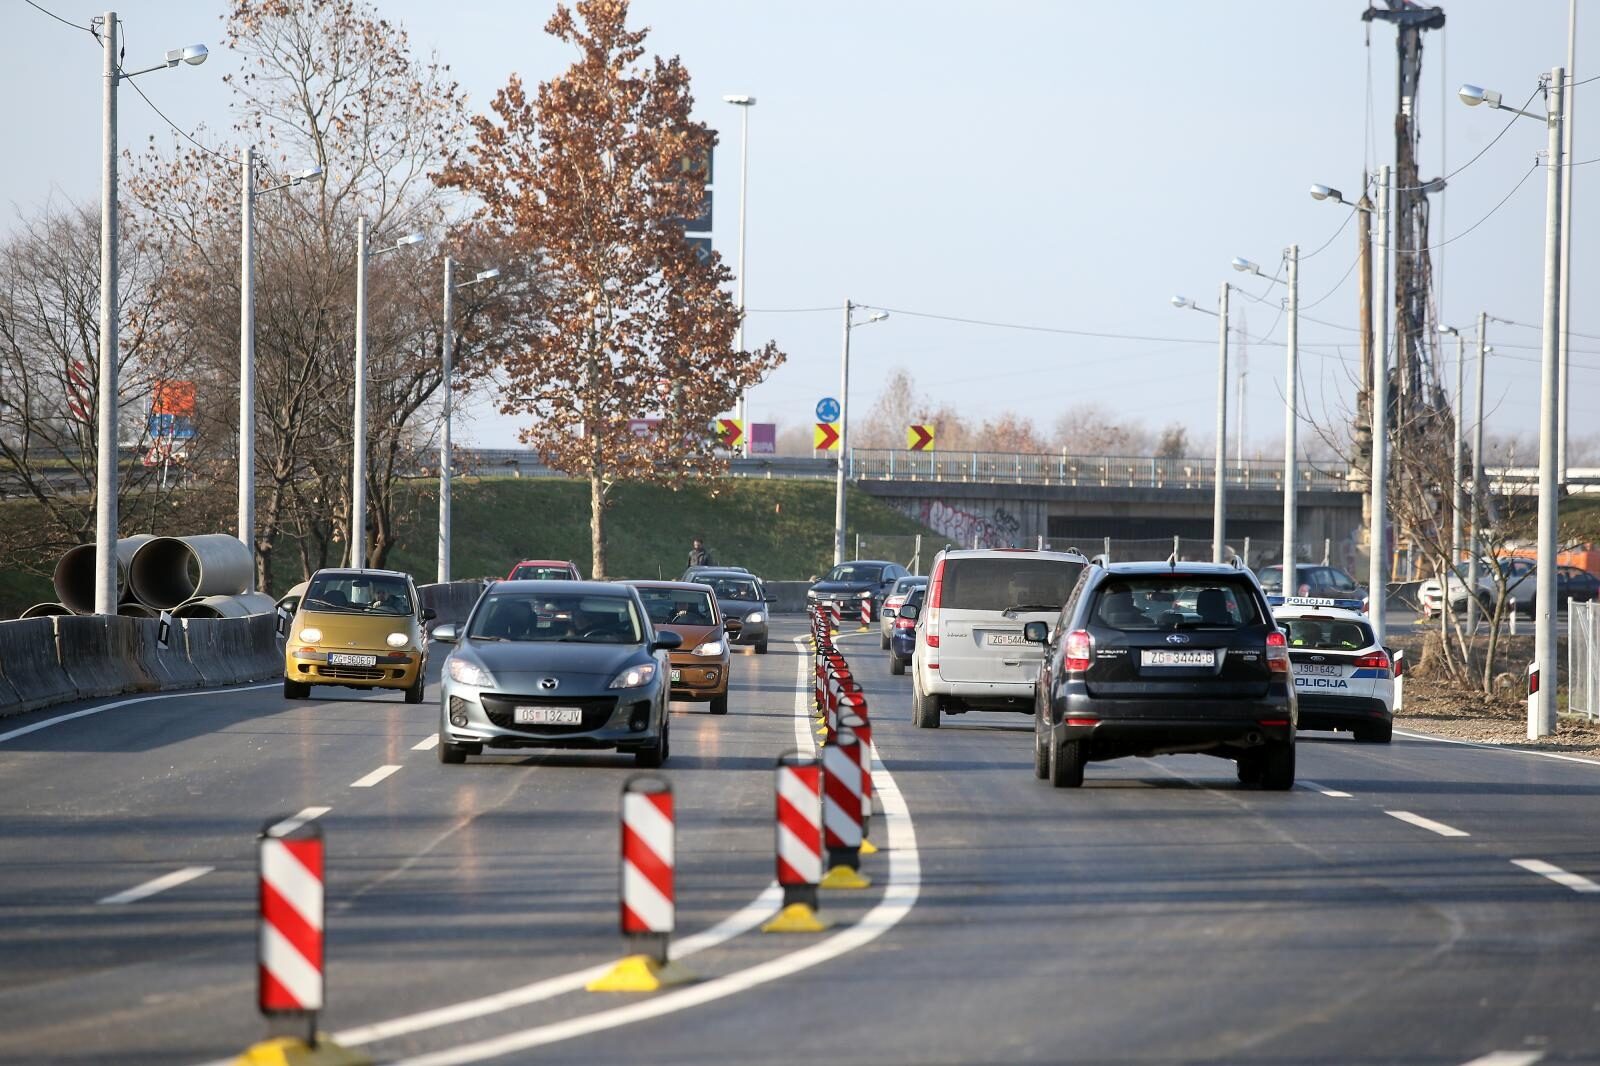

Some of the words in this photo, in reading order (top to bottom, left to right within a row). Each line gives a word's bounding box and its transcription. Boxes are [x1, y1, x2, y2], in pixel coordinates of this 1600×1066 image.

[1286, 597, 1332, 606] POLICIJA
[1151, 652, 1164, 664] ZG
[1299, 664, 1314, 673] 190
[1320, 665, 1335, 674] 642
[1294, 677, 1349, 688] OLICIJA
[522, 709, 535, 721] OS
